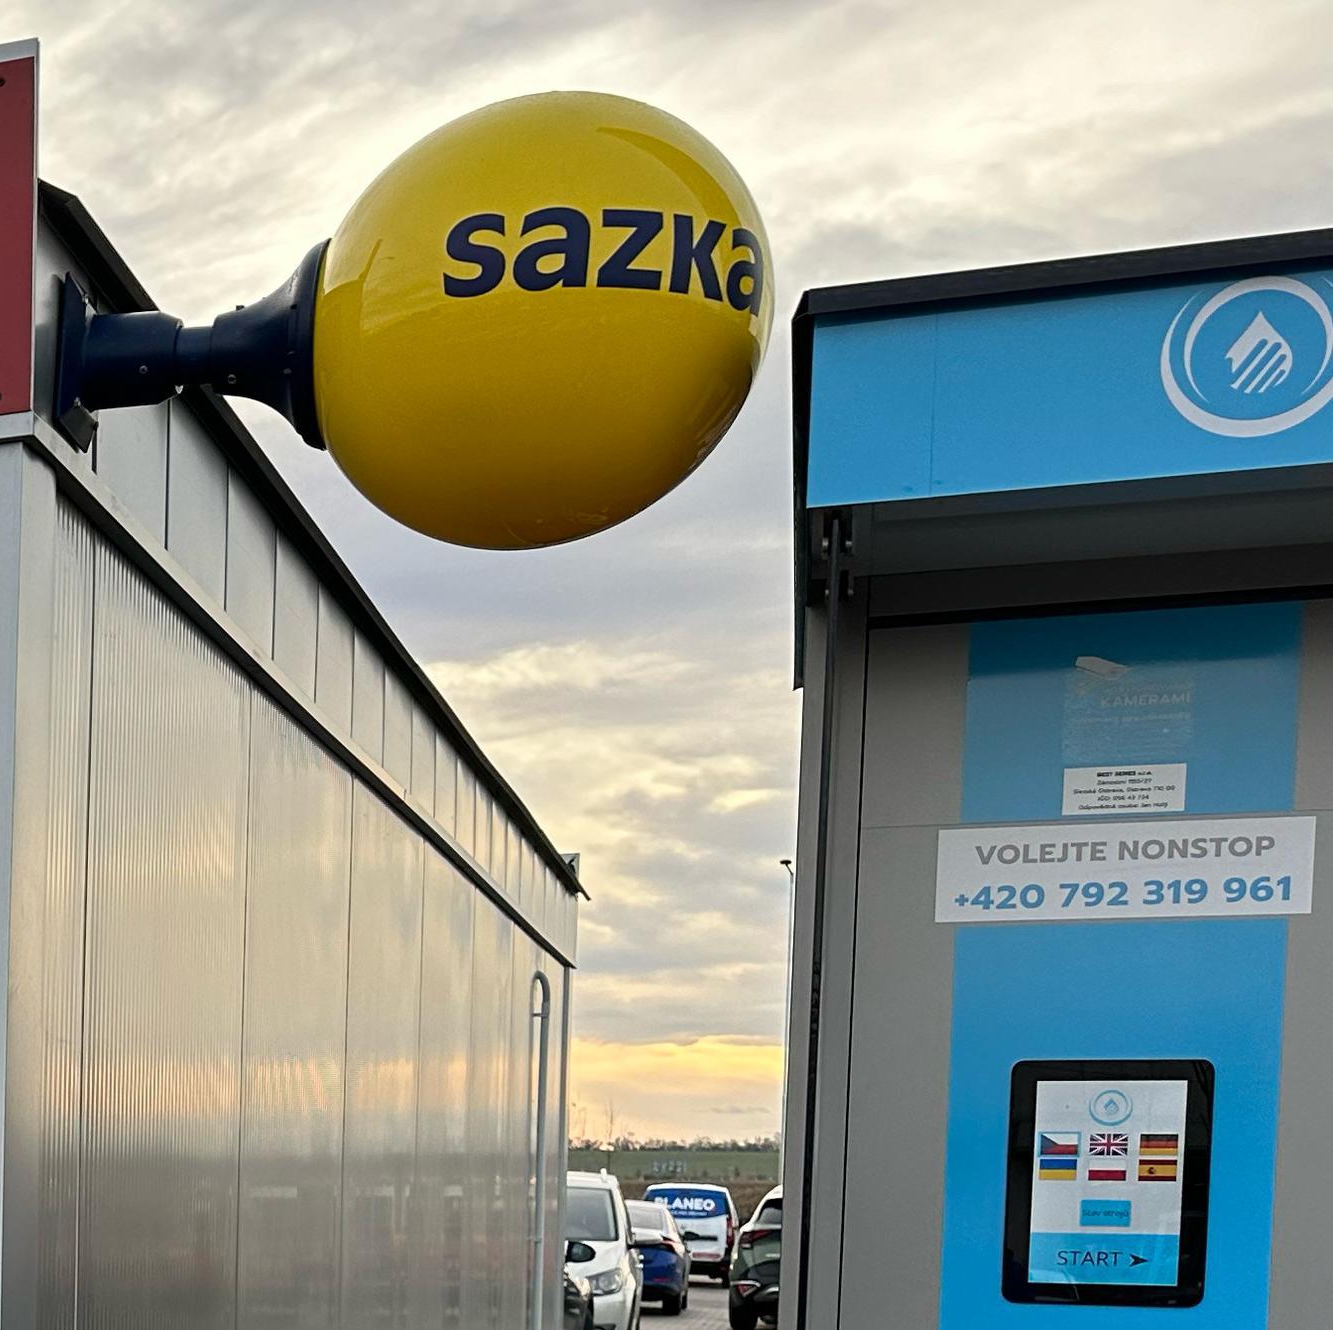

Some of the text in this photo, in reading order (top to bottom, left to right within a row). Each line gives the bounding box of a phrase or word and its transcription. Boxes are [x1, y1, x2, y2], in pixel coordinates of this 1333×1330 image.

[443, 206, 760, 317] sazka
[975, 835, 1276, 866] VOLEJTE NONSTOP
[954, 875, 1293, 911] +420 792 319 961
[1057, 1250, 1123, 1267] START
